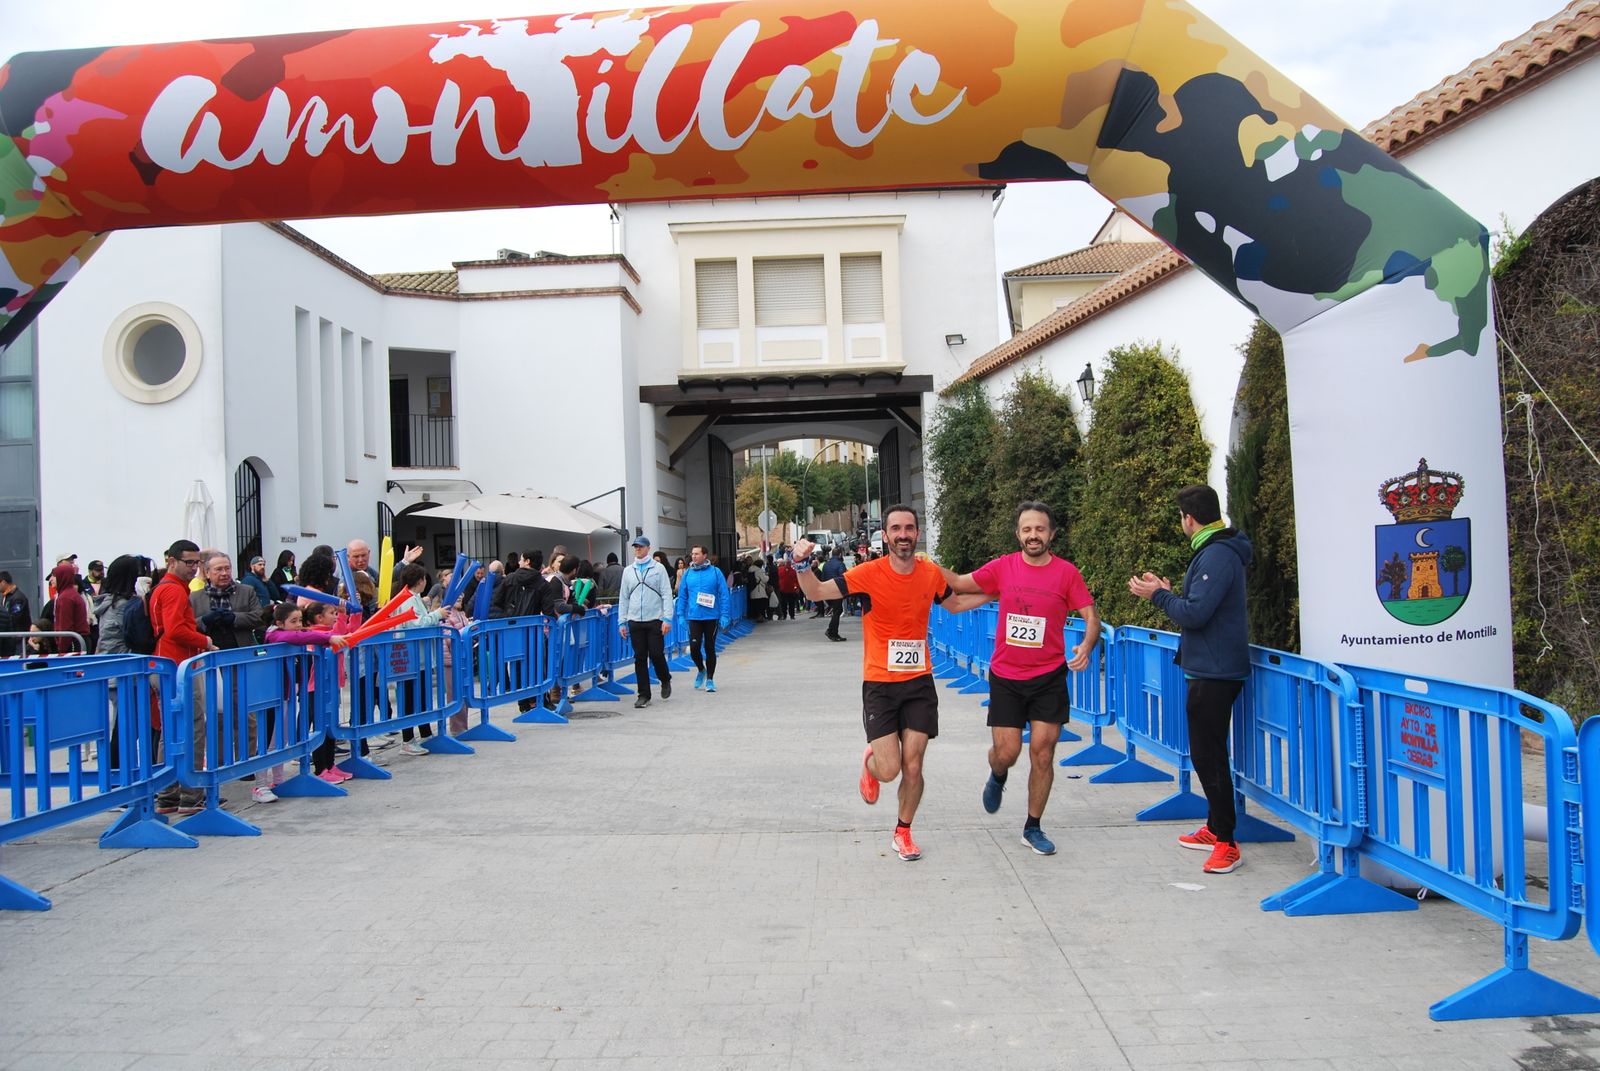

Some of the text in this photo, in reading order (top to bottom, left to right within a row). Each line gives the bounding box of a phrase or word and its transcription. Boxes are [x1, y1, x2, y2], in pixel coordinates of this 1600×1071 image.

[1011, 625, 1037, 641] 223
[1341, 625, 1497, 647] Ayuntamiento de Montilla
[895, 651, 919, 664] 220
